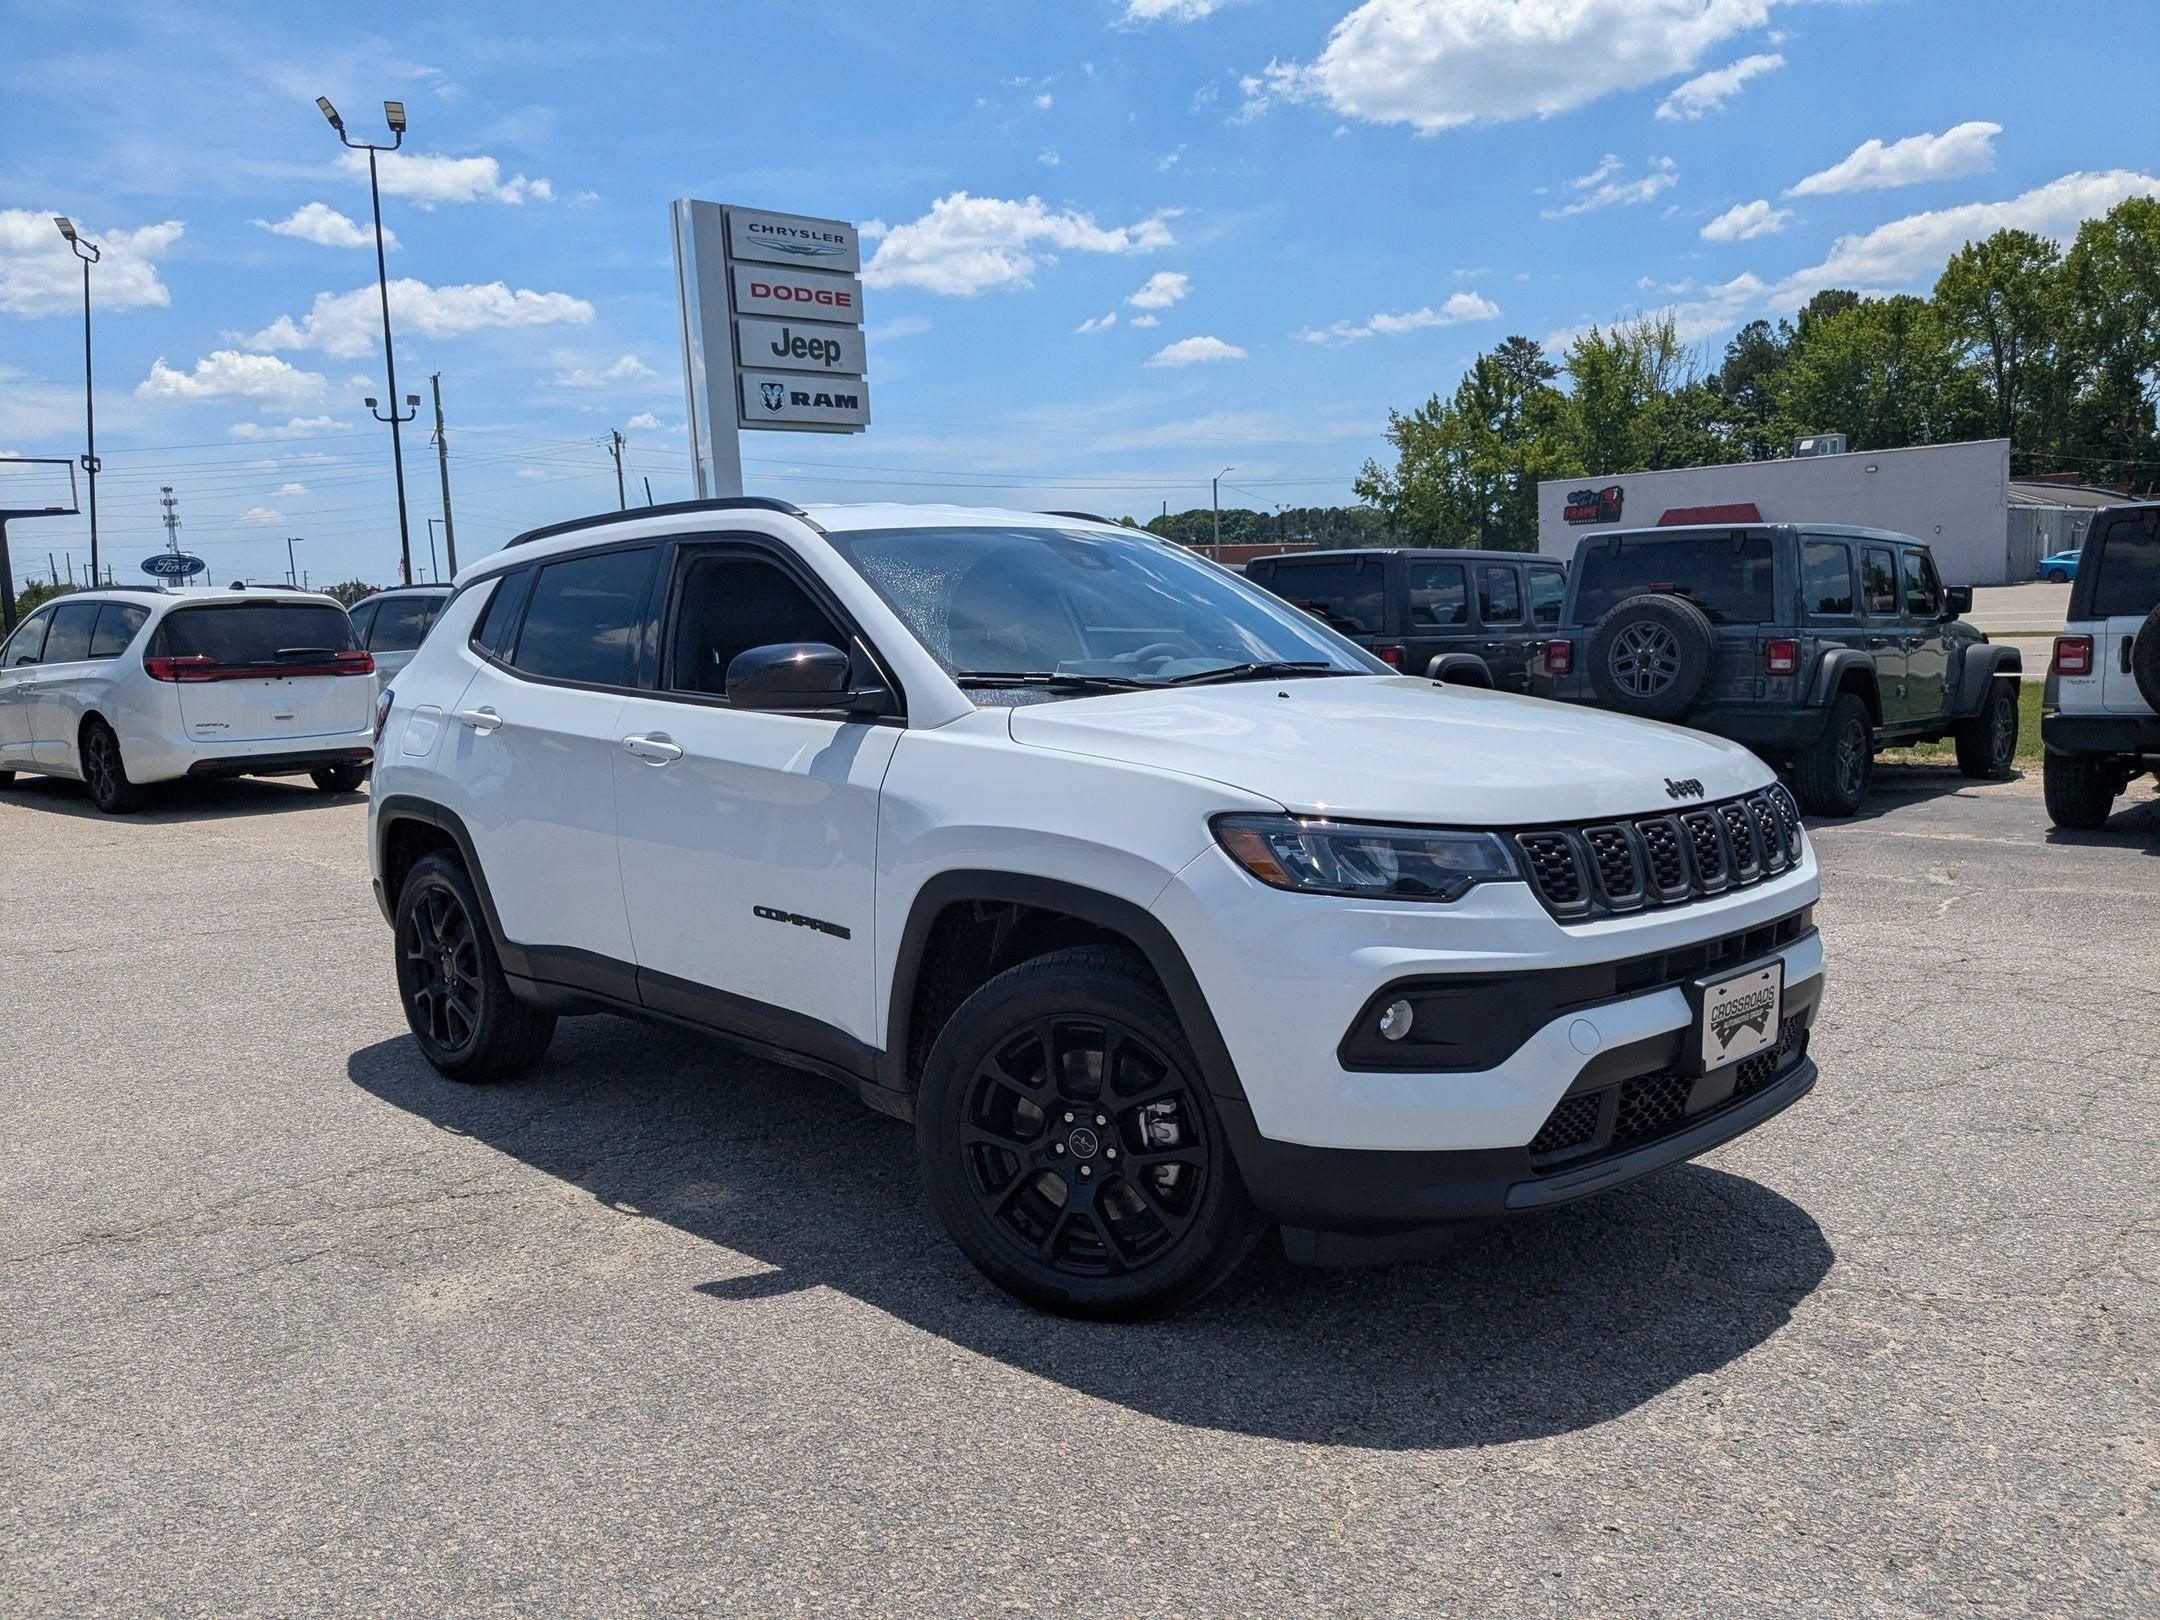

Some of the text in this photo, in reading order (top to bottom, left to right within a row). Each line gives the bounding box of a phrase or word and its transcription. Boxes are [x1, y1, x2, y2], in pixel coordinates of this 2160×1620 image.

[748, 223, 845, 244] CHRYSLER
[751, 282, 852, 308] DODGE
[771, 328, 841, 367] Jeep
[790, 392, 859, 410] RAM
[155, 559, 192, 573] Ford
[1664, 778, 1704, 800] Jeep
[1711, 985, 1775, 1021] CROSSROADS
